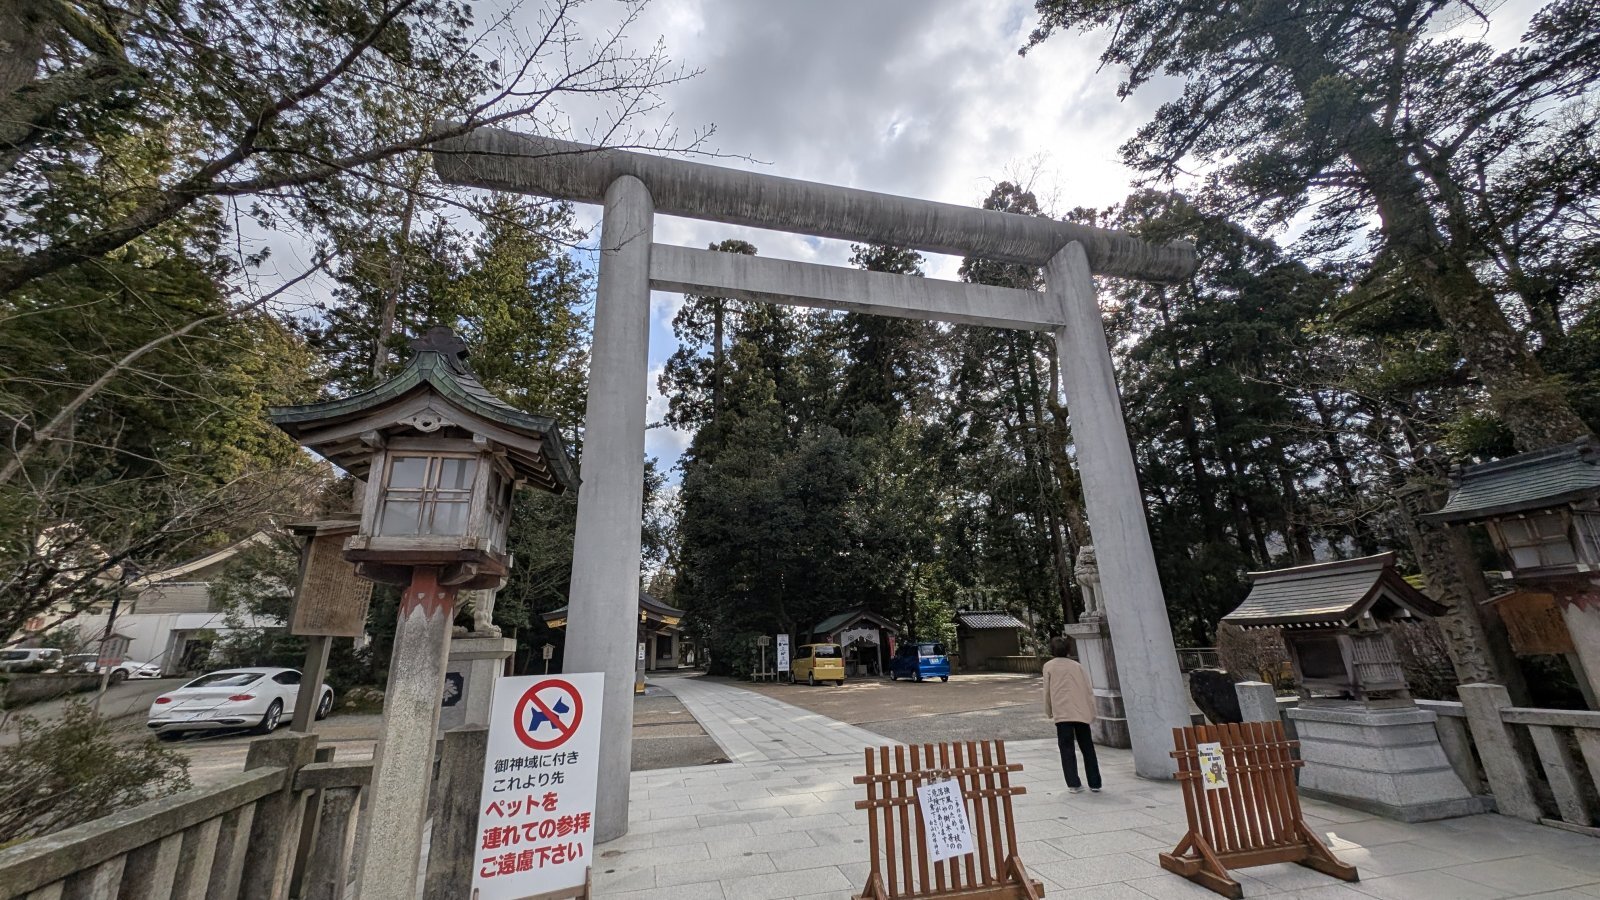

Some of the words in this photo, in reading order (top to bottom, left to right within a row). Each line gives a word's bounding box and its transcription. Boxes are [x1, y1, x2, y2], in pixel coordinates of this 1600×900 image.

[494, 751, 579, 773] 御神域に付き
[493, 772, 564, 792] これより先
[485, 792, 558, 818] ペットを
[482, 812, 591, 849] 連れての参拝
[480, 843, 583, 878] ご遠慮下さい
